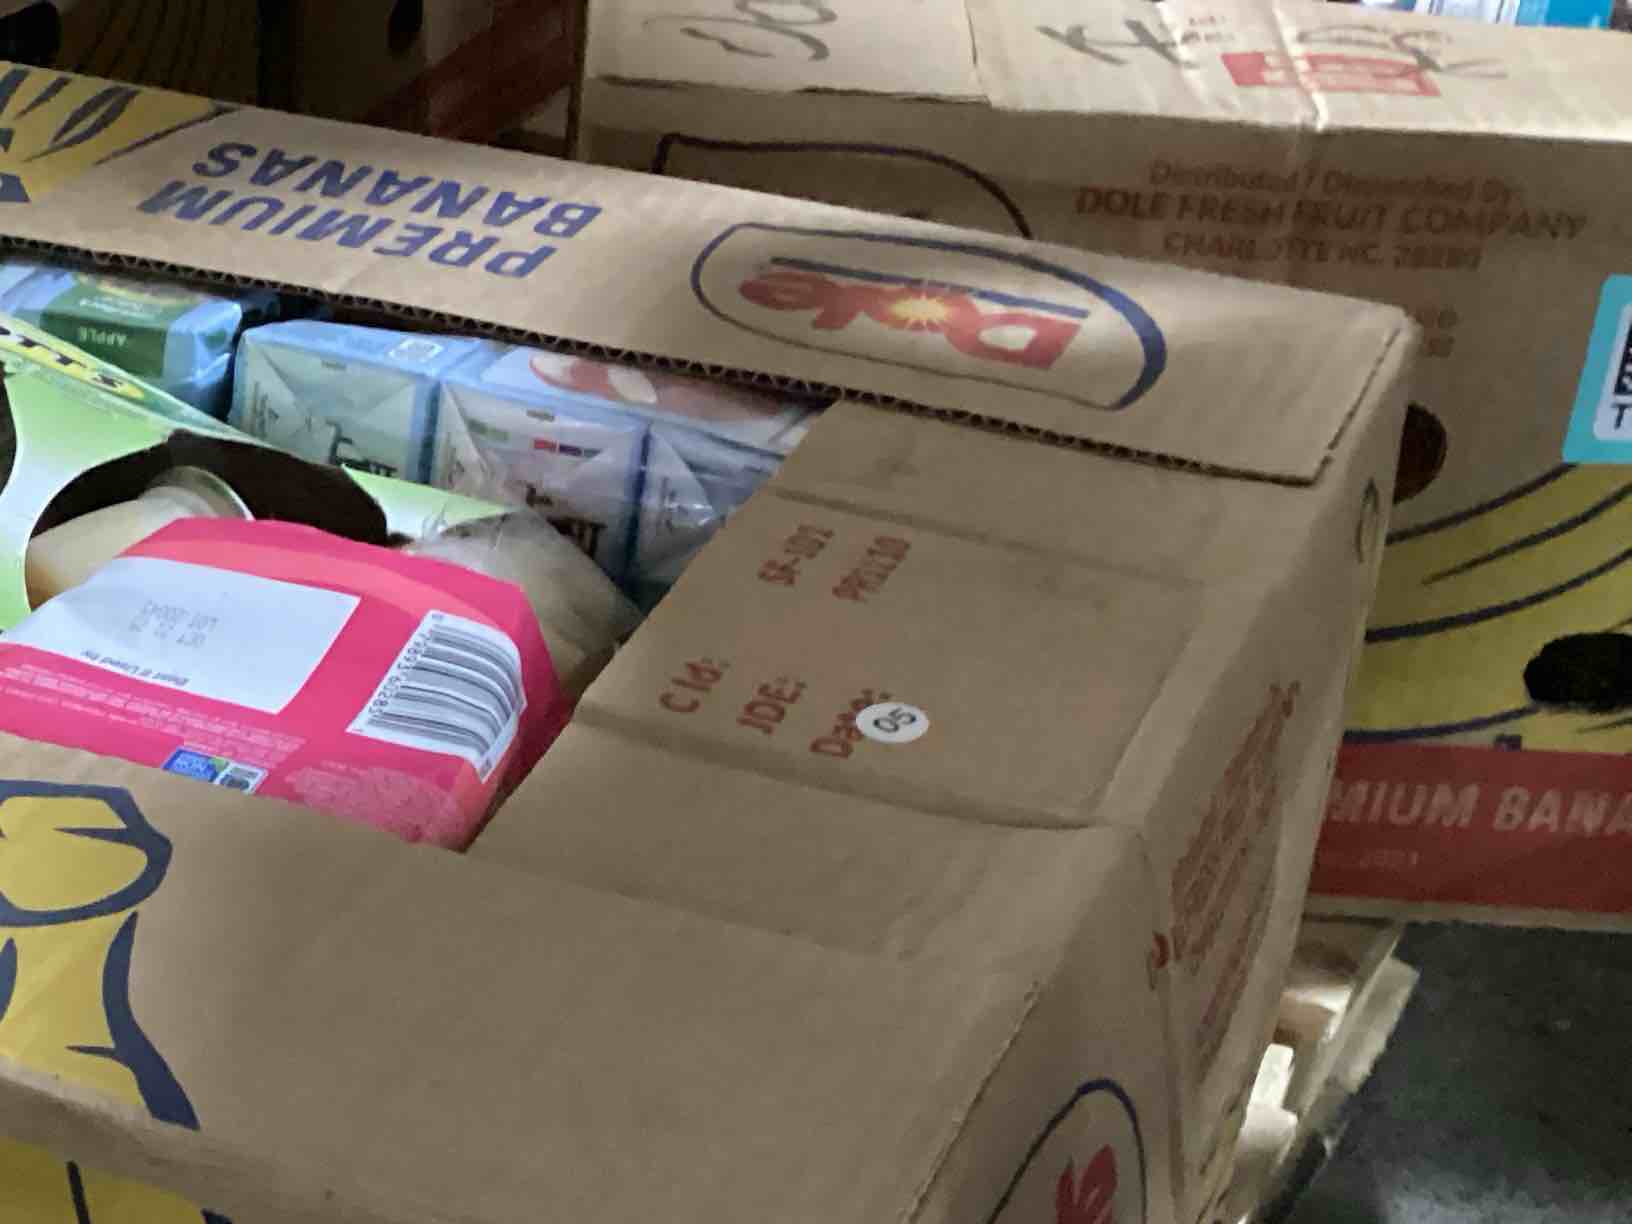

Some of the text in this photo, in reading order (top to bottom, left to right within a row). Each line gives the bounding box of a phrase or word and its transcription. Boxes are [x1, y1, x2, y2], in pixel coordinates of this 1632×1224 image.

[137, 179, 559, 279] PREMIUM
[192, 142, 602, 239] BANANAS
[1074, 187, 1588, 240] DOLE FRESH FRUIT COMPANY
[78, 326, 128, 346] APPLE
[737, 268, 1085, 371] Dole
